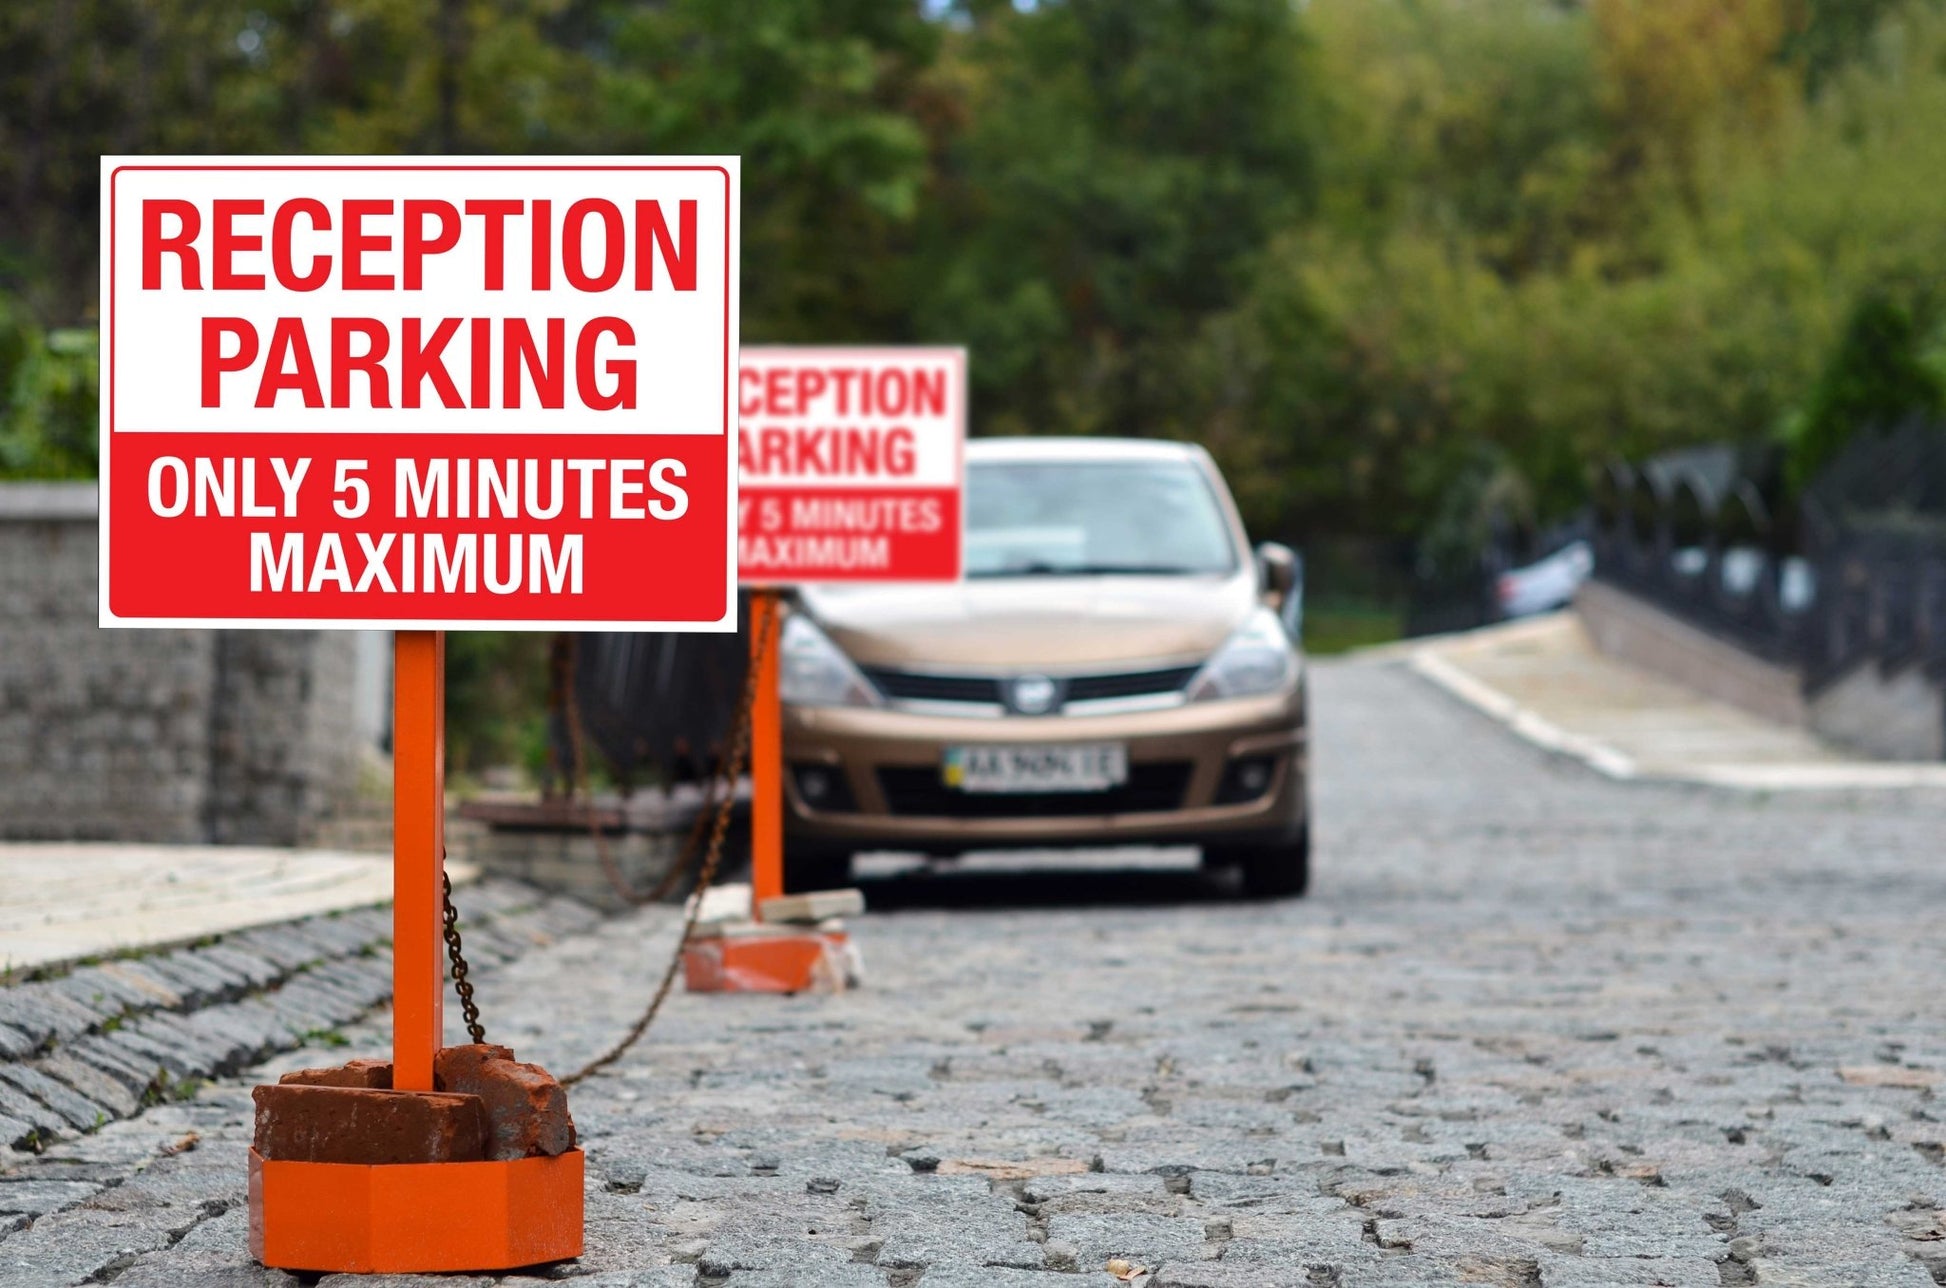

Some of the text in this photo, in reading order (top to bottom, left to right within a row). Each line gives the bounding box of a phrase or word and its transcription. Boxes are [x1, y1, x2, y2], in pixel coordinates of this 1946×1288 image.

[143, 198, 697, 292] RECEPTION
[202, 317, 637, 411] PARKING
[740, 367, 946, 417] CEPTION
[148, 456, 311, 518] ONLY
[333, 460, 370, 519] 5
[395, 459, 689, 521] MINUTES
[760, 498, 783, 531] 5
[791, 498, 942, 532] MINUTES
[251, 533, 583, 595] MAXIMUM
